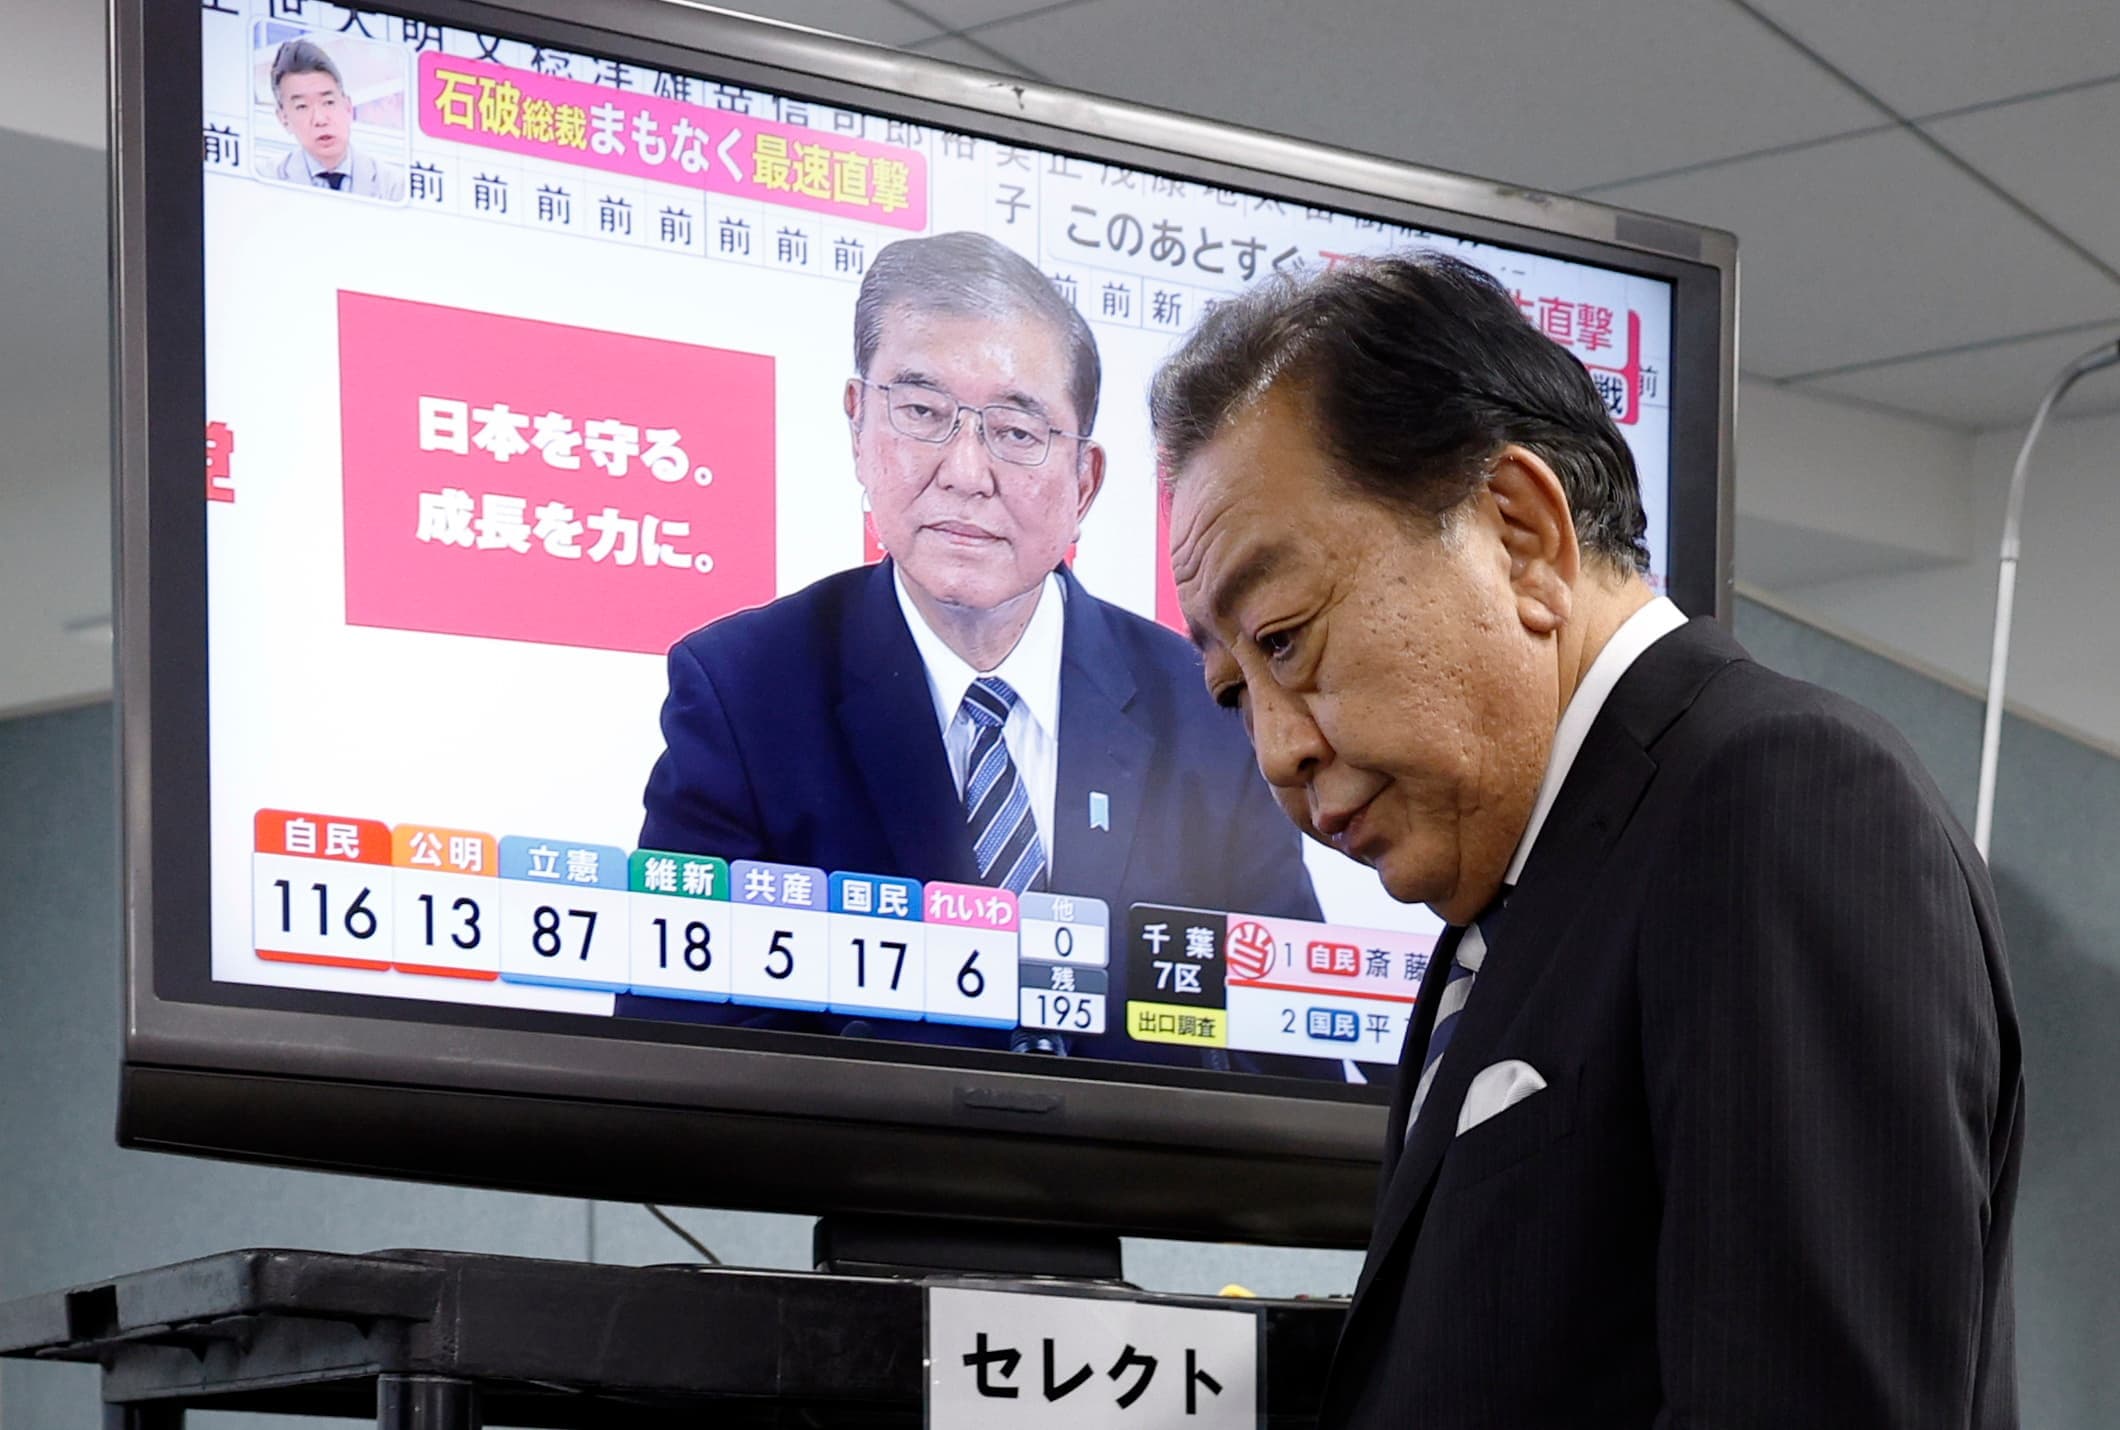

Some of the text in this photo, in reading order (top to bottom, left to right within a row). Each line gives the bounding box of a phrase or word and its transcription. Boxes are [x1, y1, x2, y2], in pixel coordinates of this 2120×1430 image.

[203, 123, 240, 167] 前
[434, 67, 912, 213] 石破総裁まもなく最速直撃
[410, 161, 864, 275] 前 前 前 前 前 前 前 前
[1103, 281, 1131, 319] 前
[1153, 290, 1182, 327] 新
[418, 395, 713, 487] 日本を守る。
[416, 488, 715, 574] 成長を力に。
[285, 818, 1014, 926] 自民 公明 立憲 維新 共産 国民 れいわ
[1052, 897, 1075, 922] 他
[274, 880, 1074, 998] 116 13 87 18 5 17 6 0
[1142, 922, 1215, 960] 千葉
[1284, 942, 1294, 968] 1
[1310, 946, 1359, 973] 自民
[1051, 966, 1076, 992] 残
[1153, 961, 1202, 994] 7区
[1037, 995, 1092, 1030] 195
[1138, 1010, 1217, 1040] 出口調査
[1281, 1009, 1297, 1034] 2
[1310, 1010, 1358, 1038] 国民
[963, 1332, 1224, 1416] セレクト
